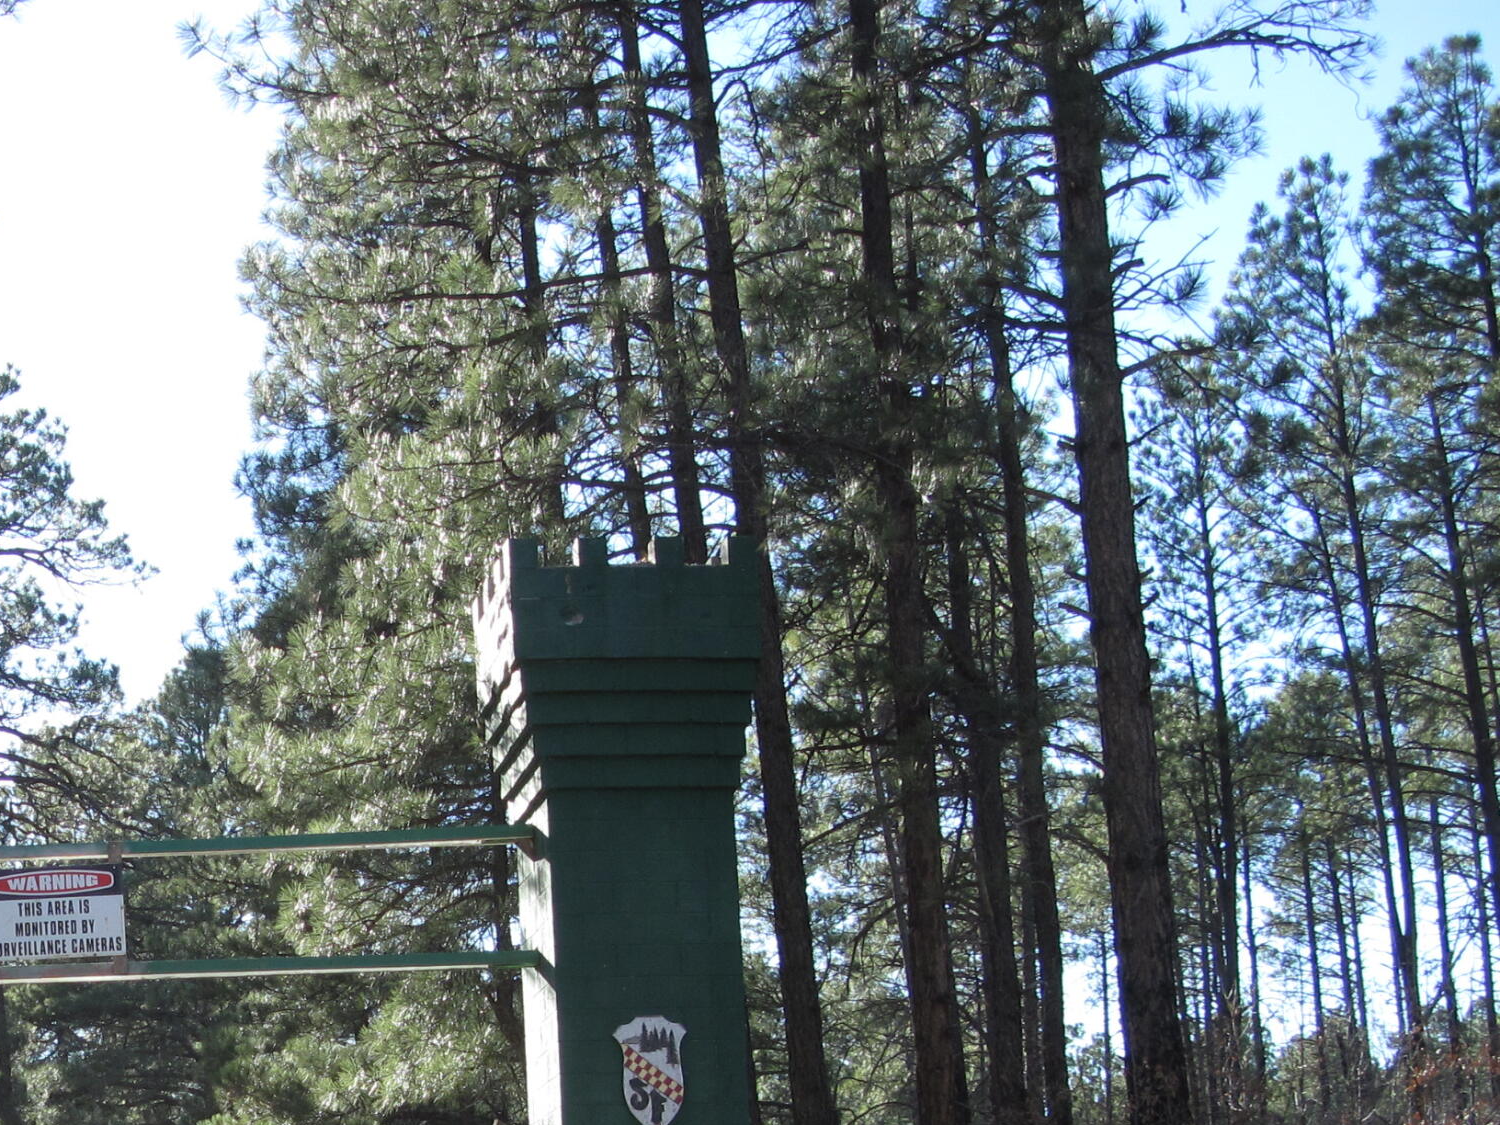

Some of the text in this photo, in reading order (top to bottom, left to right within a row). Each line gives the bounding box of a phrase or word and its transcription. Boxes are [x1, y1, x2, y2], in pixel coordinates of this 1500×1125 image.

[7, 873, 99, 891] WARNING
[18, 899, 90, 917] THIS AREA IS
[15, 919, 95, 937] MONITORED BY
[71, 936, 122, 953] CAMERAS
